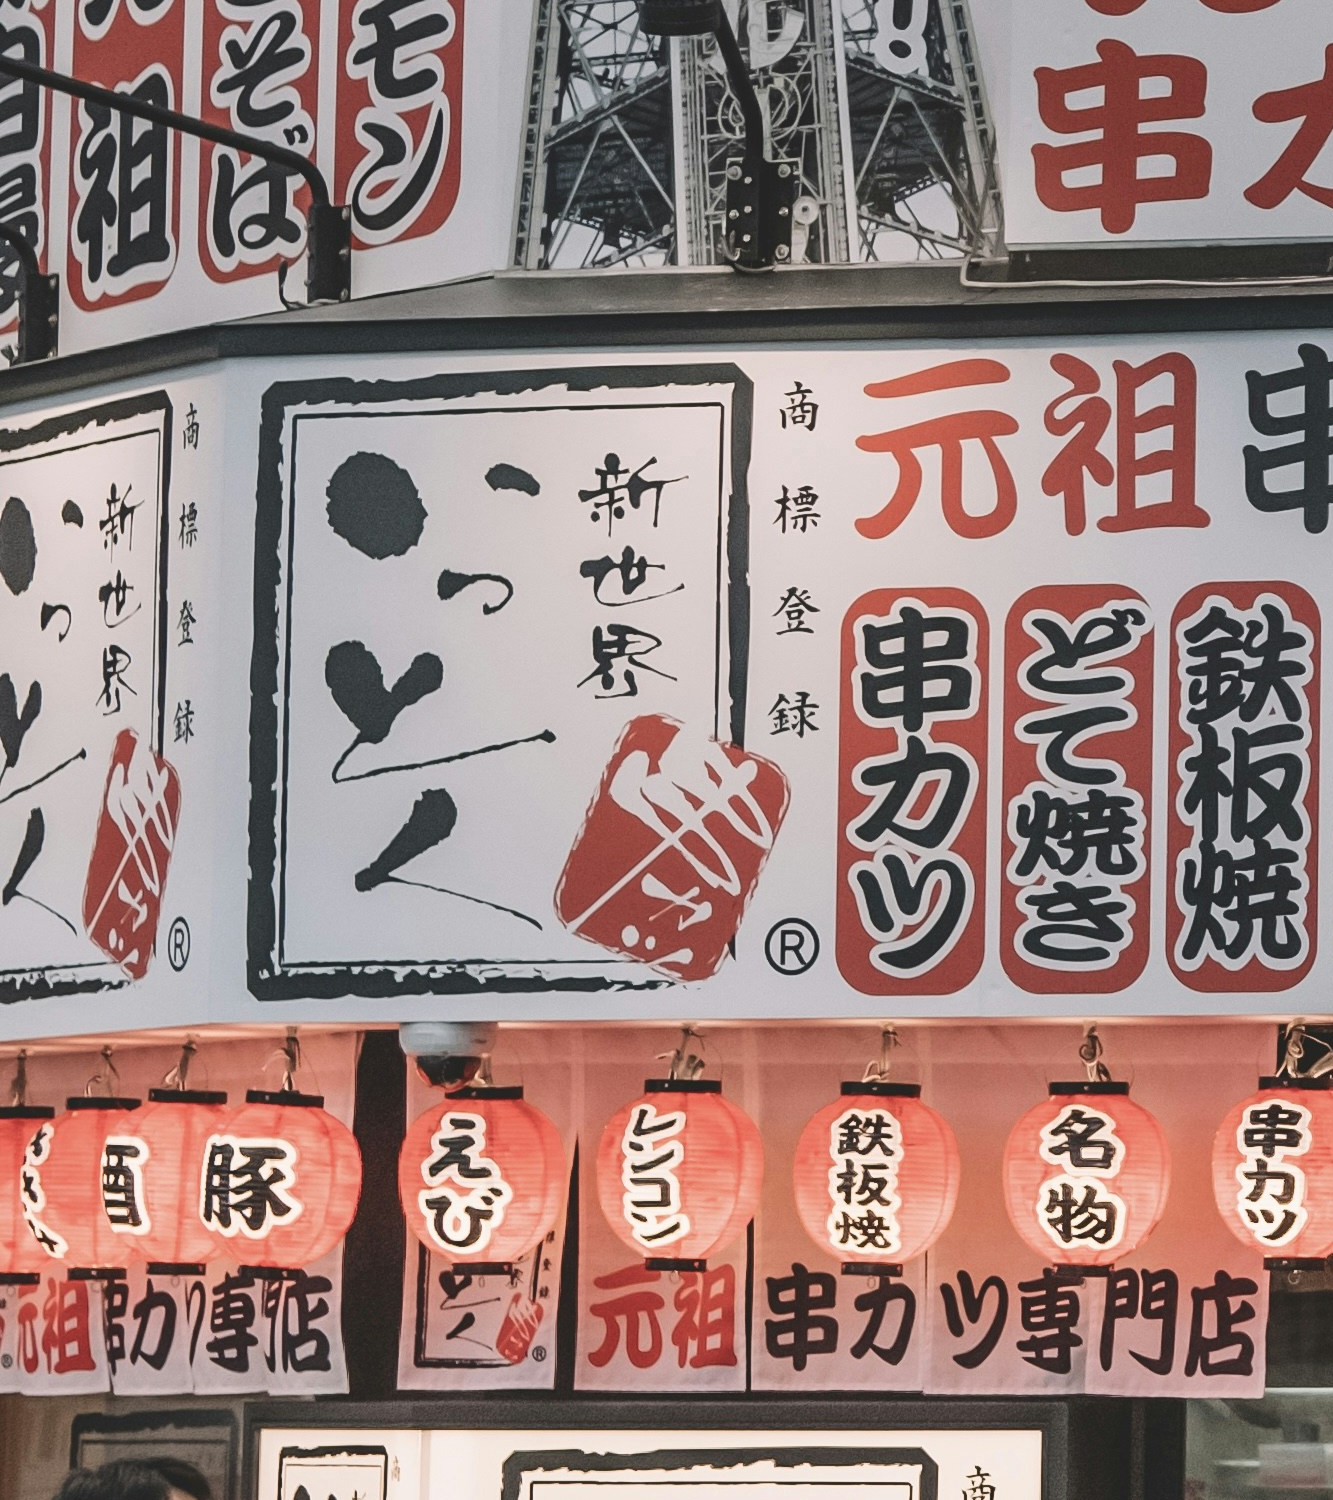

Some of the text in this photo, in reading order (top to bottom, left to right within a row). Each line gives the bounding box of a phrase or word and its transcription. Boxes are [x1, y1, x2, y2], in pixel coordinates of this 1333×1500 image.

[96, 482, 146, 716] 新世界
[173, 410, 200, 745] 商標登録
[576, 452, 690, 700] 新世界
[767, 381, 821, 738] 商標登録
[854, 606, 971, 968] 串カツ
[1015, 608, 1146, 963] どて焼き
[1182, 603, 1307, 962] 鉄板焼
[205, 1142, 292, 1230] 豚
[426, 1118, 508, 1248] えび
[630, 1107, 684, 1242] レンコン
[836, 1113, 896, 1249] 鉄板焼
[1046, 1109, 1117, 1244] 名物
[1242, 1104, 1303, 1242] 串カツ
[587, 1261, 1259, 1378] 元祖串カツ専門店
